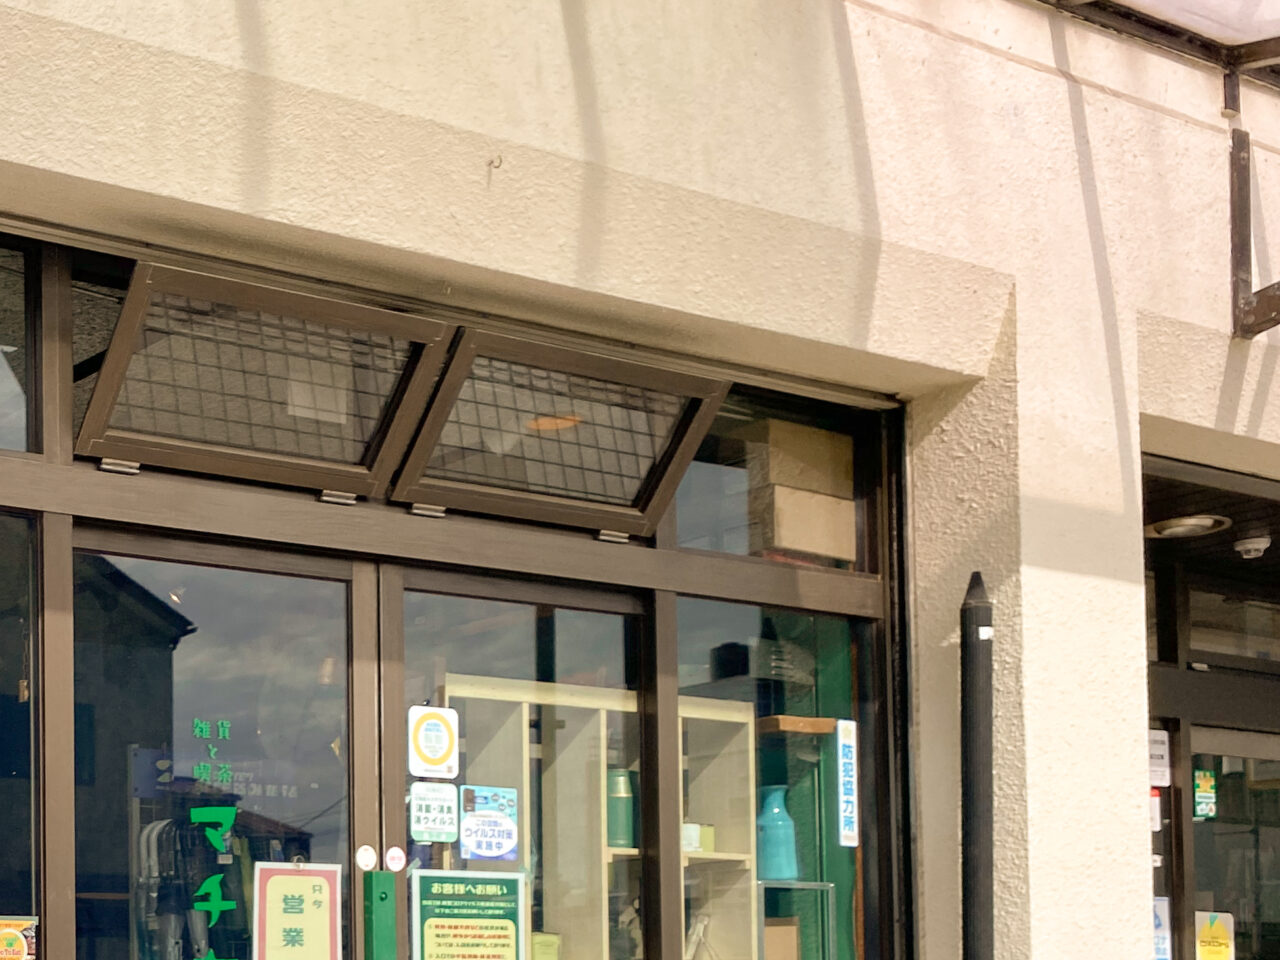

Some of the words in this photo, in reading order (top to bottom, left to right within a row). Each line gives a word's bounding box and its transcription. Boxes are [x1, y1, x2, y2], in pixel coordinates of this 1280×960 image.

[431, 882, 508, 896] お客様へお願い
